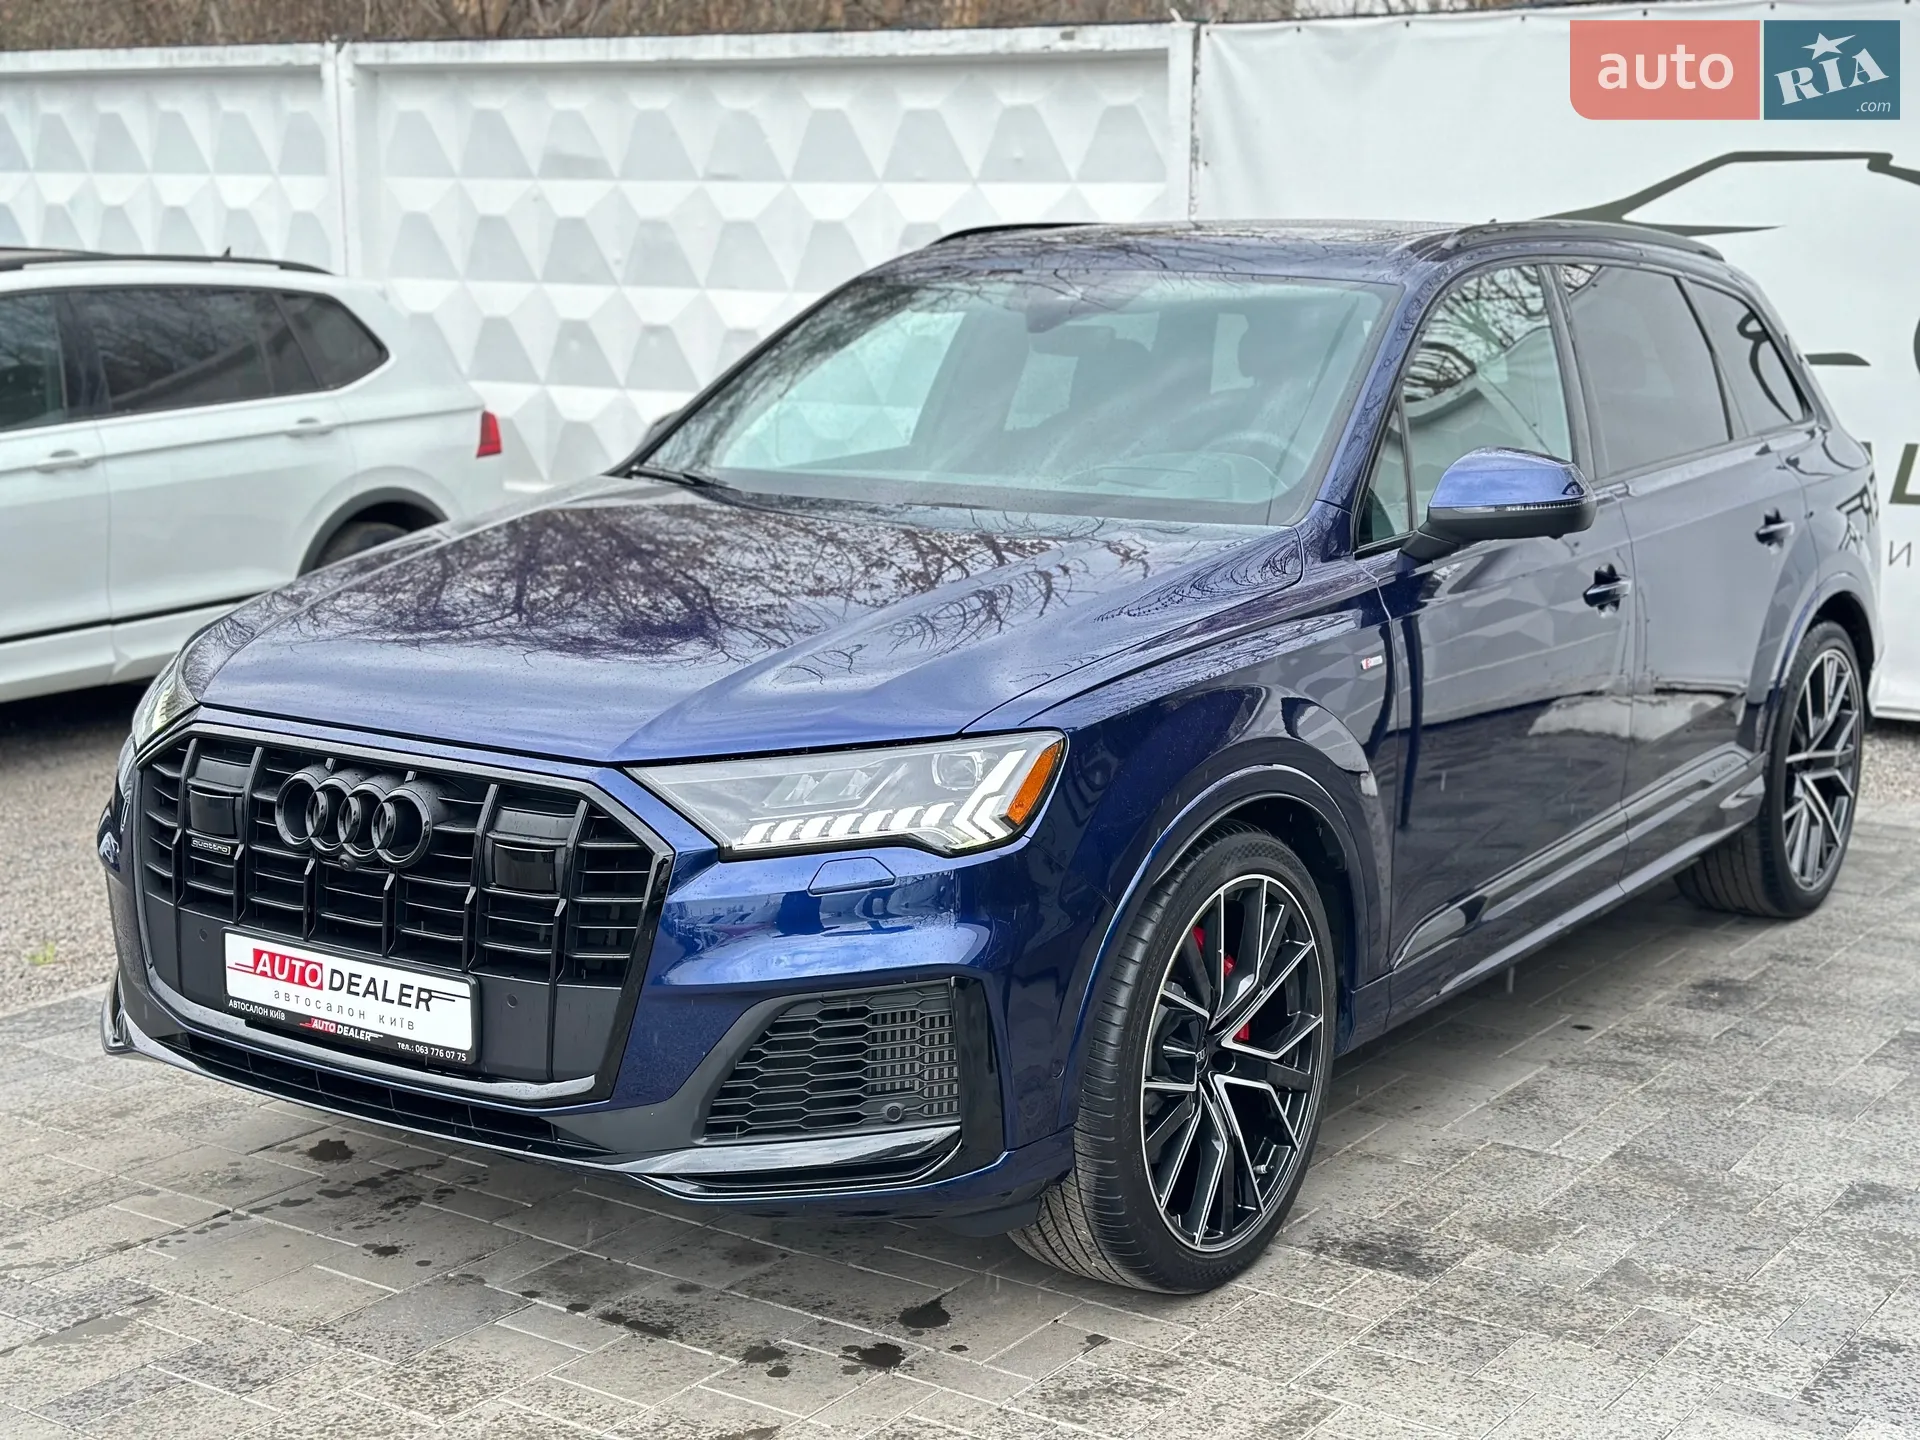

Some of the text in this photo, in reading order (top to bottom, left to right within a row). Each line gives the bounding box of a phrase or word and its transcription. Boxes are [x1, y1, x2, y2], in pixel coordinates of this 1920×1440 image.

[191, 838, 229, 853] quattro
[255, 953, 432, 1012] AUTO DEALER
[228, 999, 286, 1021] АВТОСАЛОН КИЇВ
[274, 989, 415, 1031] автосалон київ
[312, 1019, 371, 1042] AUTO DEALER
[415, 1044, 429, 1055] 063
[430, 1047, 444, 1058] 776
[445, 1050, 455, 1060] 07
[457, 1052, 467, 1062] 75
